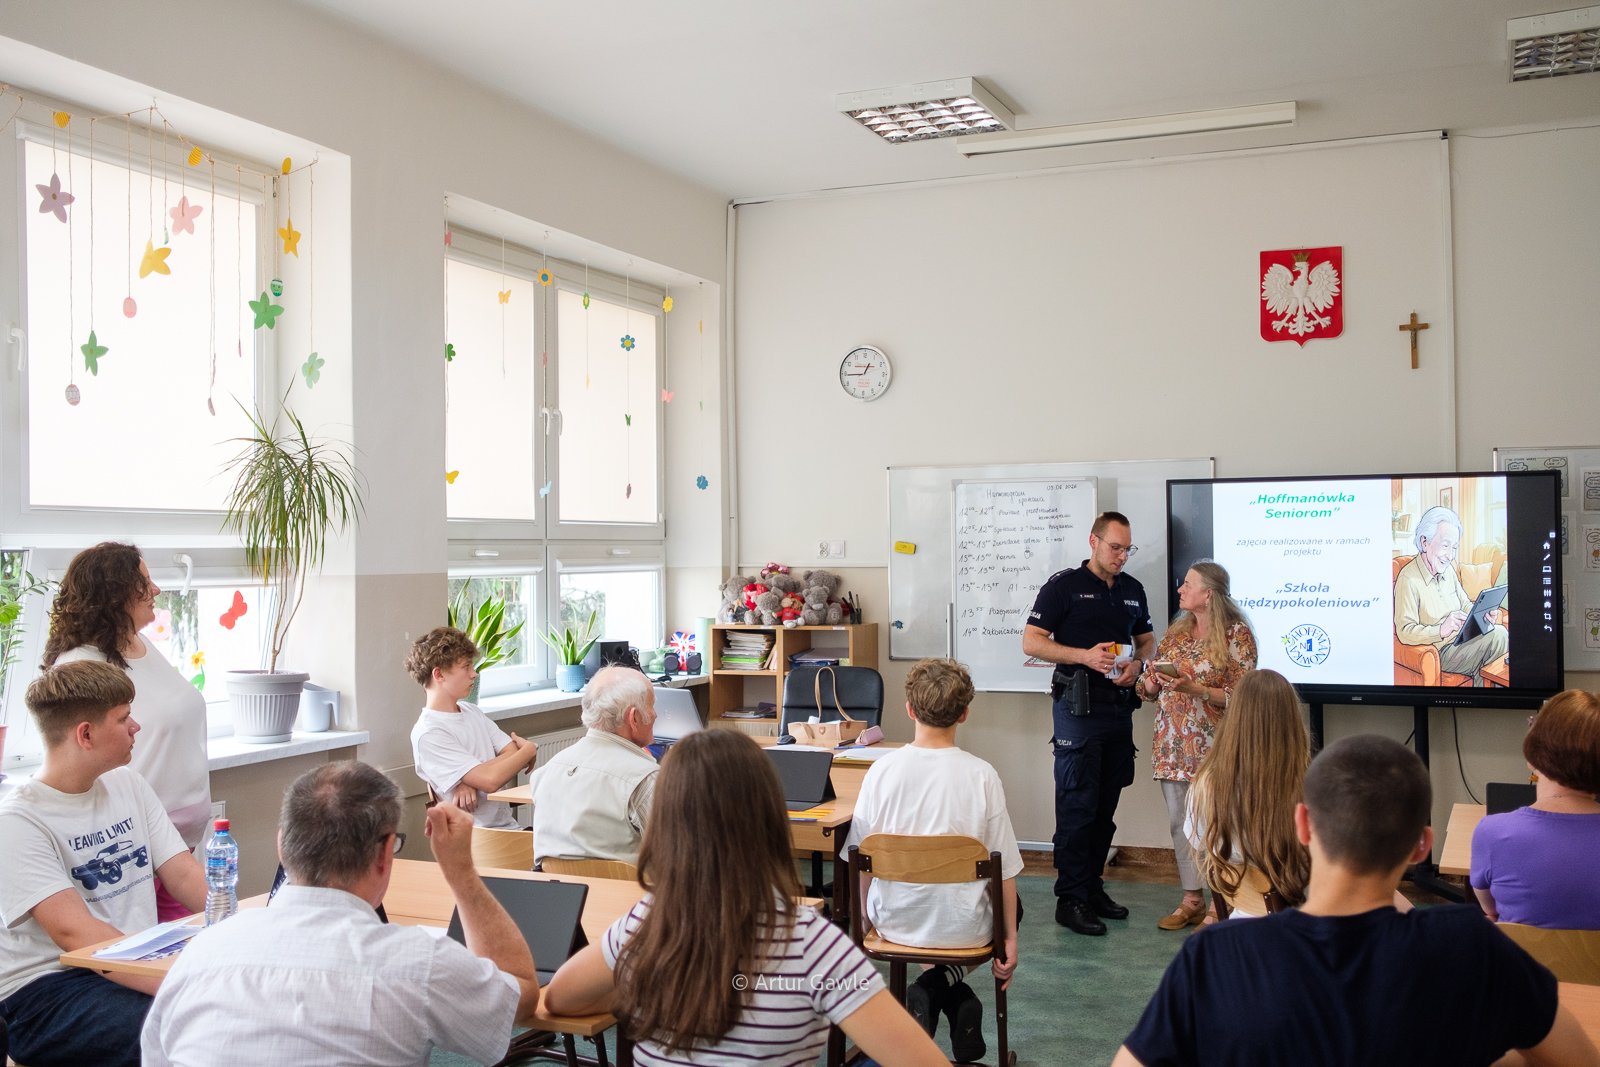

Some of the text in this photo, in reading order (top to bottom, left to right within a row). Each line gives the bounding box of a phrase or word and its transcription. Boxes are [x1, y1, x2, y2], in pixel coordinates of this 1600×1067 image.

[1236, 538, 1267, 547] zajęcia
[1269, 537, 1323, 545] realizowane
[1335, 537, 1371, 545] ramach
[1283, 548, 1322, 557] projektu
